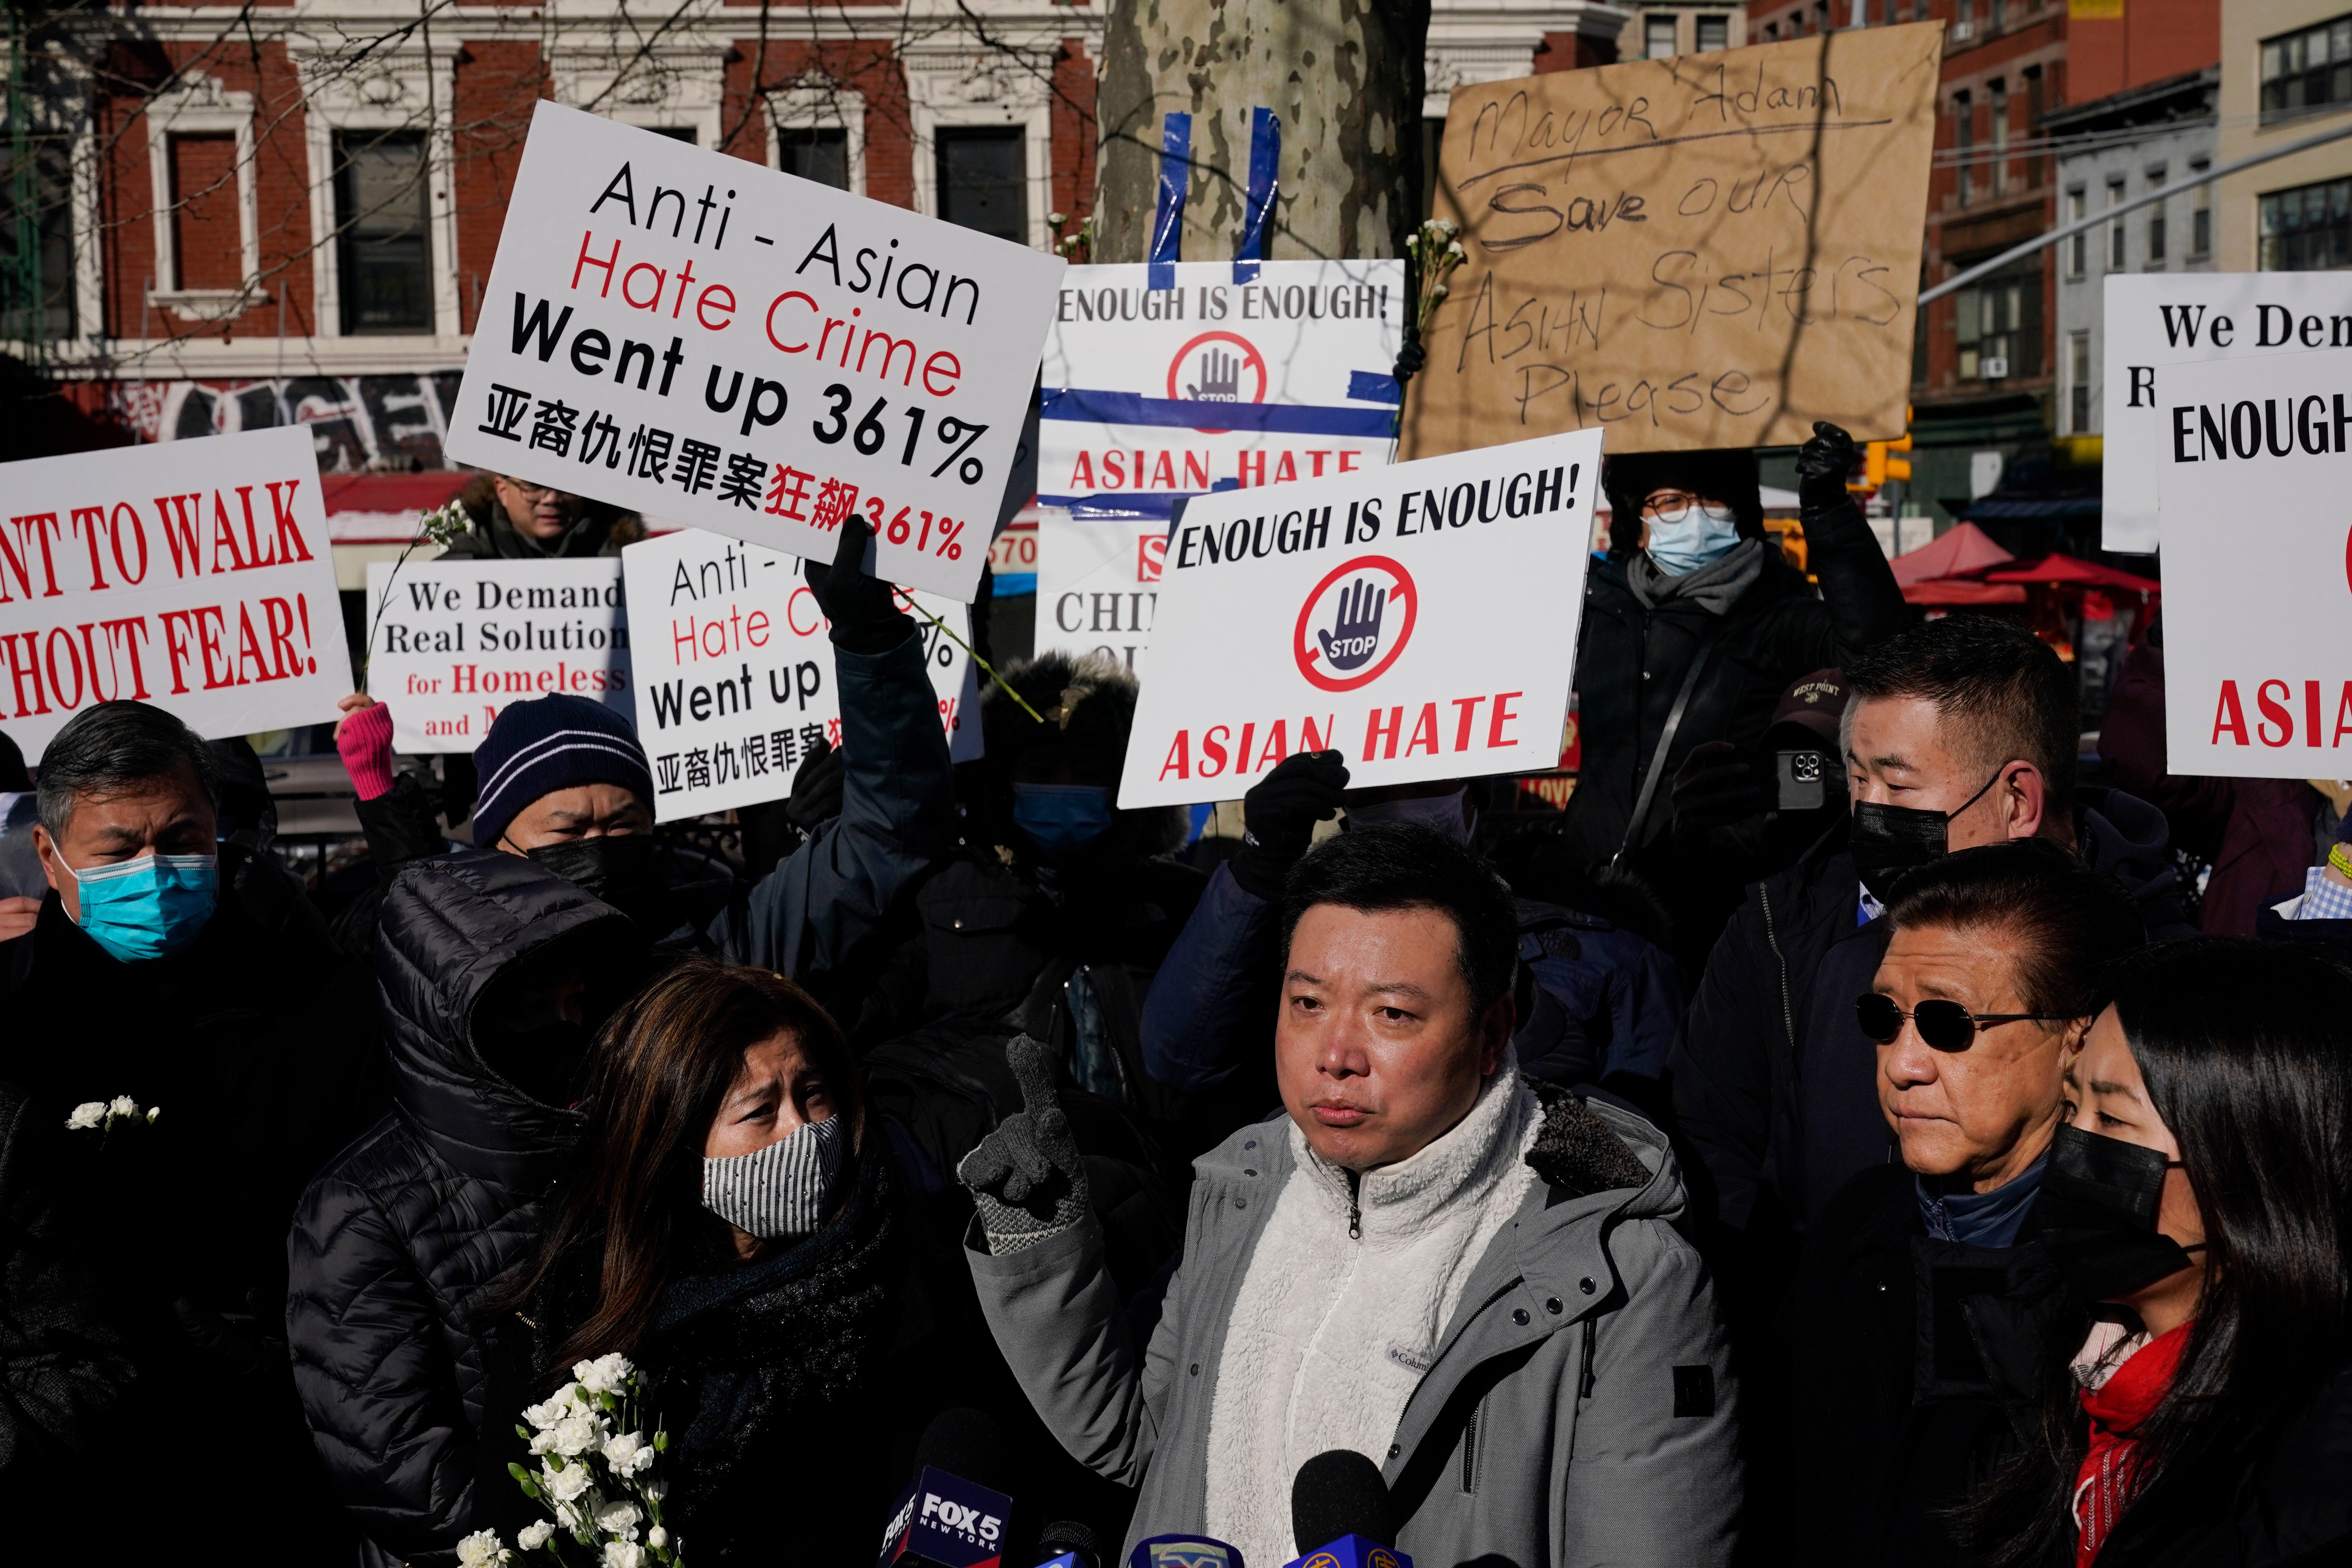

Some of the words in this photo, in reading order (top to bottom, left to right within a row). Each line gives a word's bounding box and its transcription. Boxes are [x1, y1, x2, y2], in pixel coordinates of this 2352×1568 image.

[1689, 60, 1841, 121] Adam
[589, 161, 736, 250] Anti
[795, 223, 979, 325] Asian
[1481, 183, 1648, 252] Save
[571, 230, 736, 331] Hate
[766, 290, 961, 397] Crime
[1058, 287, 1185, 322] ENOUGH
[1199, 286, 1228, 320] IS
[1242, 285, 1388, 319] ENOUGH!
[2160, 305, 2234, 347] We
[512, 291, 684, 397] Went
[705, 364, 788, 437] up
[813, 383, 990, 485] 361%
[1515, 363, 1770, 427] Please
[1071, 450, 1210, 490] ASIAN
[70, 502, 148, 591] TO
[153, 479, 314, 579] WALK
[1177, 506, 1332, 569] ENOUGH
[1345, 498, 1382, 544] IS
[1396, 463, 1580, 537] ENOUGH!
[408, 582, 461, 611] We
[475, 578, 624, 610] Demand
[671, 540, 747, 606] Anti
[158, 593, 317, 695] FEAR!
[385, 622, 465, 653] Real
[673, 604, 769, 665] Hate
[1329, 635, 1377, 658] STOP
[407, 673, 441, 695] for
[451, 661, 626, 694] Homeless
[650, 663, 752, 730] Went
[769, 661, 820, 711] up
[1793, 682, 1815, 697] WEST
[1815, 682, 1840, 696] POINT
[425, 715, 469, 735] and
[1158, 714, 1334, 782] ASIAN
[1362, 691, 1523, 762] HATE
[919, 1516, 951, 1534] NEW
[958, 1530, 996, 1552] YORK
